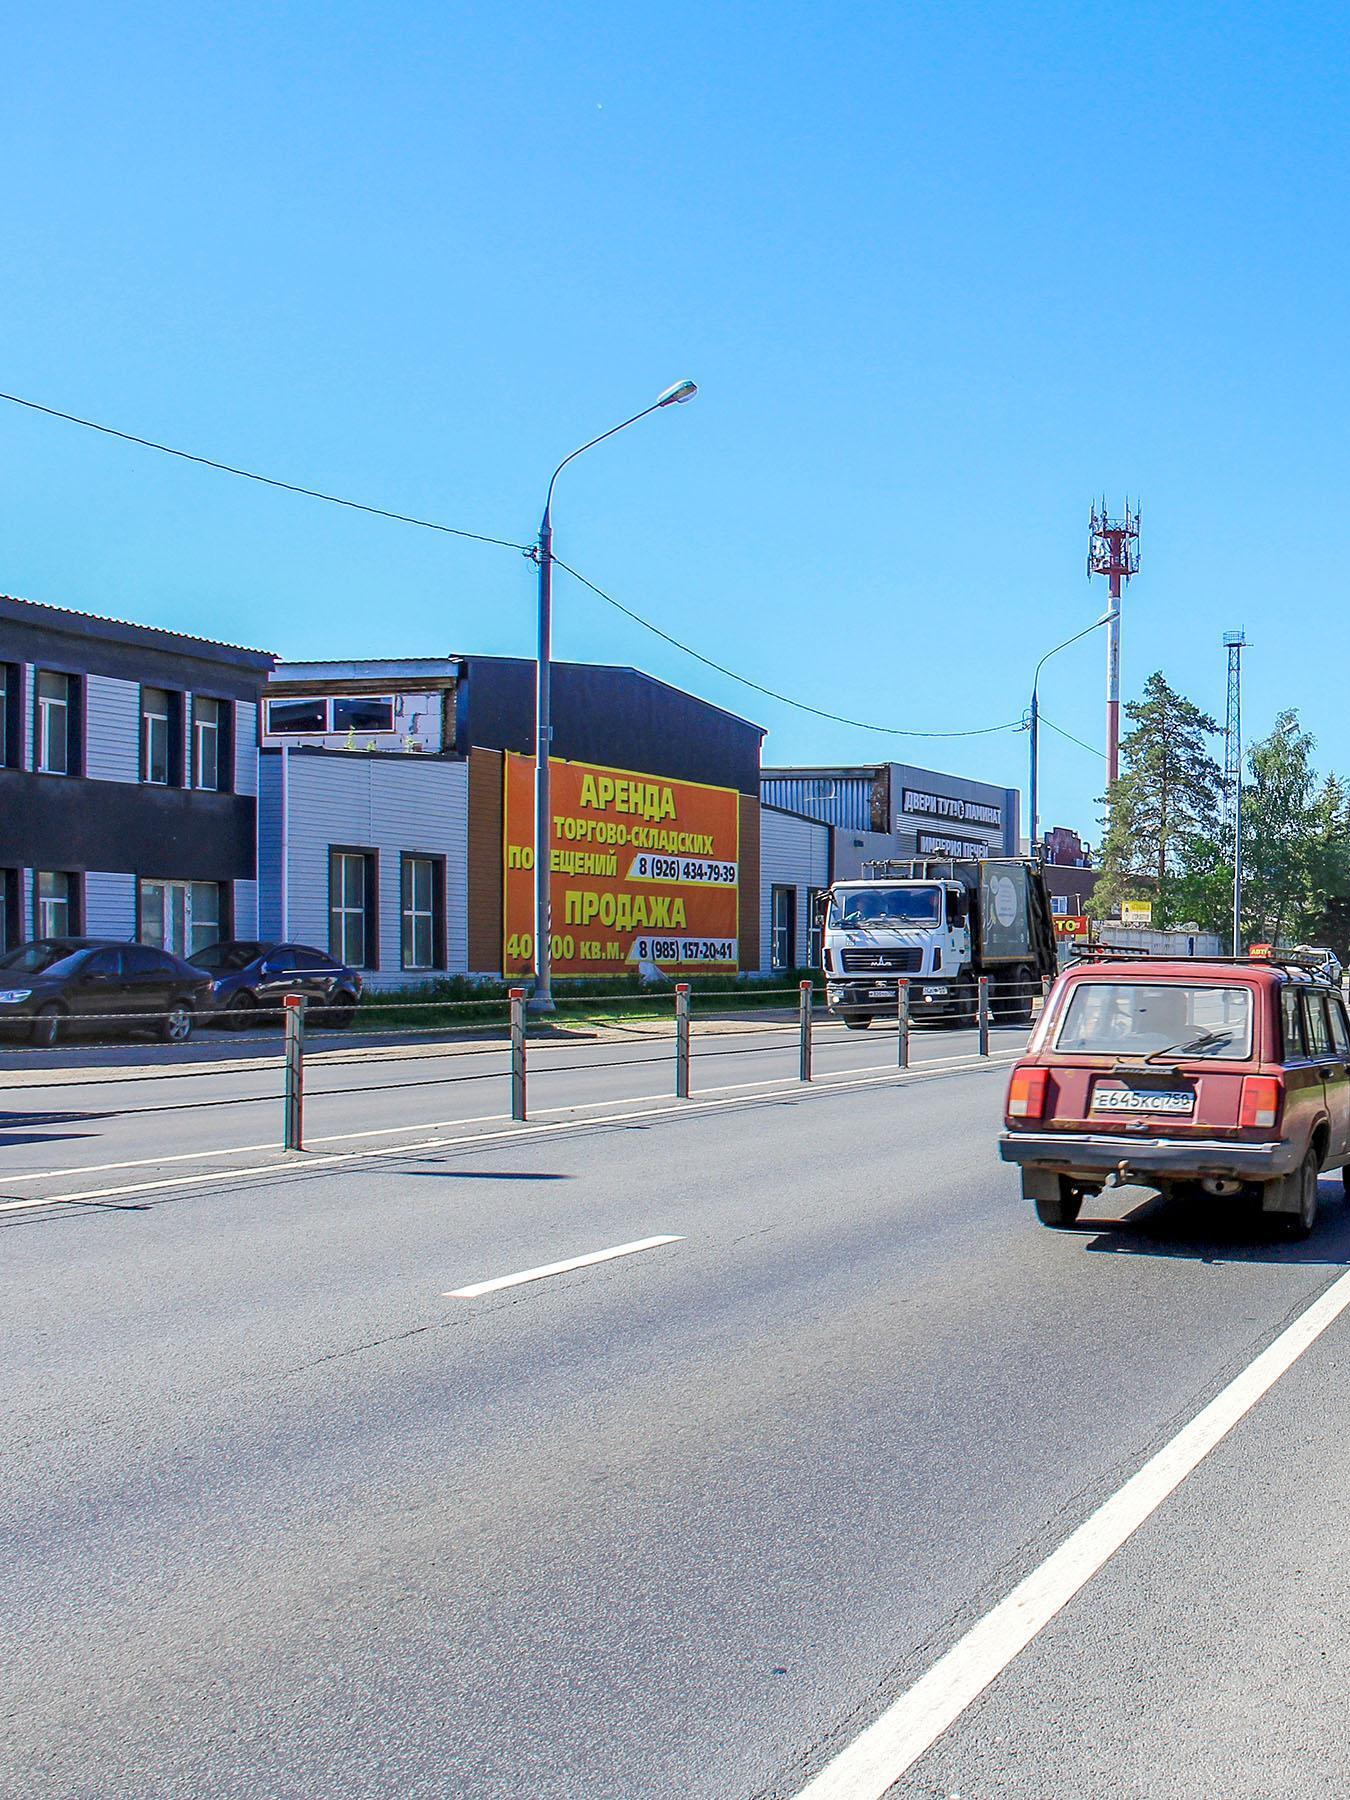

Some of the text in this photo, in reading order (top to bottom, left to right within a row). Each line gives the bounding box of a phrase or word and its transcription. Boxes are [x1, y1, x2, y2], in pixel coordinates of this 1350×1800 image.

[580, 773, 677, 822] АРЕНДА
[904, 791, 937, 813] ДВЕРИ
[965, 803, 1002, 824] ЛАМИНАТ
[553, 815, 714, 856] ТОРГОВО-СКЛАДСКИХ
[508, 845, 618, 877] ПОЕЩЕНИЙ
[639, 857, 736, 883] 8 (926) 434-79-39
[564, 890, 687, 932] ПРОДАЖА
[639, 940, 733, 961] 8 (985) 157-20-41
